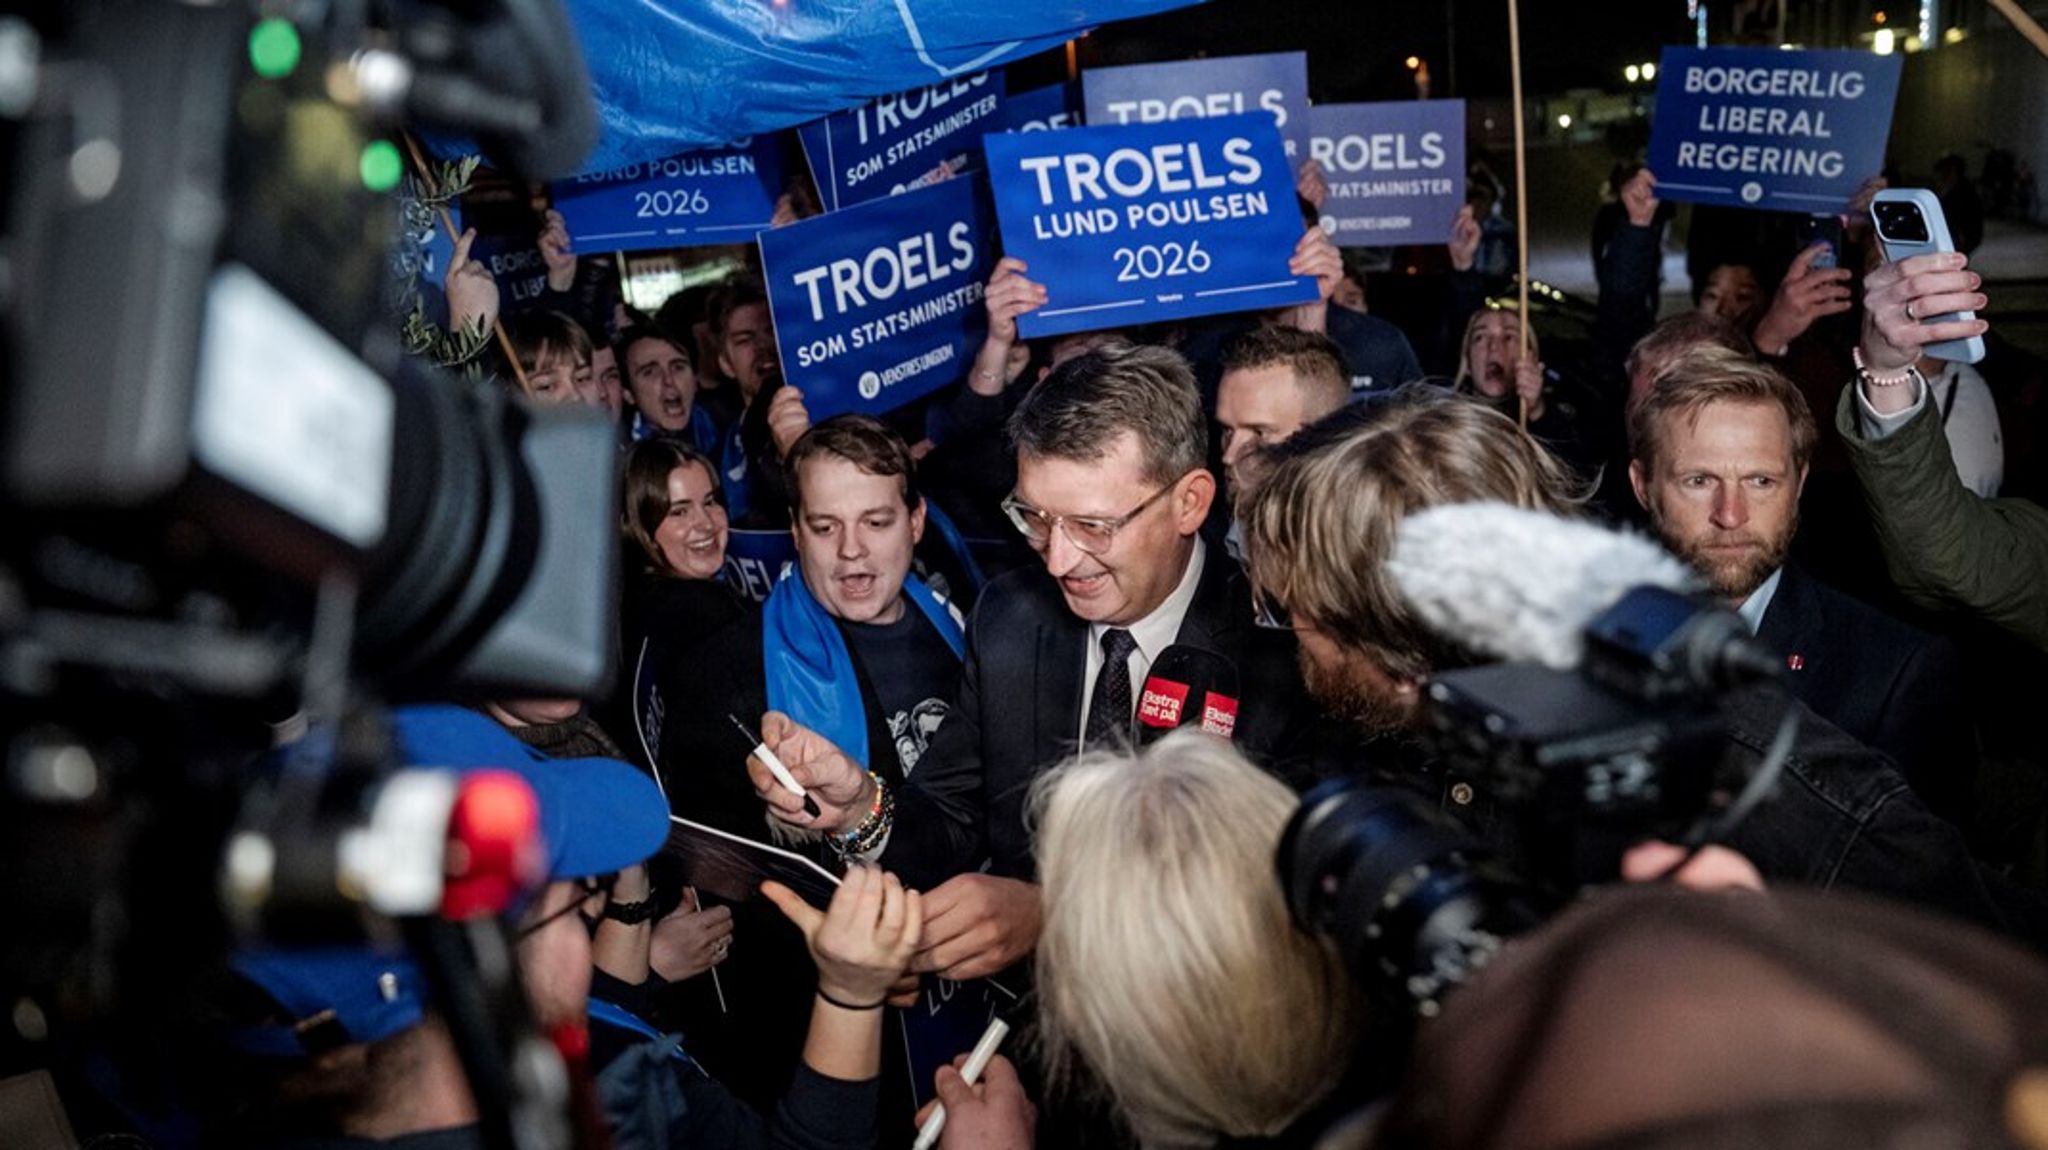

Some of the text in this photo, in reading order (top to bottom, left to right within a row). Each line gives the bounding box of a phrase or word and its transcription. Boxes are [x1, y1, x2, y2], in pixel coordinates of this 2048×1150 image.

[1685, 67, 1865, 99] BORGERLIG
[857, 70, 988, 145] TROE
[1699, 105, 1832, 138] LIBERAL
[846, 154, 883, 186] SOM
[887, 94, 997, 165] STATSMINISTER
[1310, 131, 1446, 172] ROELS
[1677, 141, 1845, 178] REGERING
[648, 155, 757, 178] POULSEN
[1020, 137, 1262, 205] TROELS
[635, 188, 710, 218] 2026
[1328, 178, 1454, 198] TATSMINISTER
[1033, 191, 1270, 240] LUND POULSEN
[491, 249, 542, 275] BORG
[793, 221, 975, 322] TROELS
[1113, 240, 1212, 282] 2026
[797, 281, 984, 368] SOM STATSMINISTER
